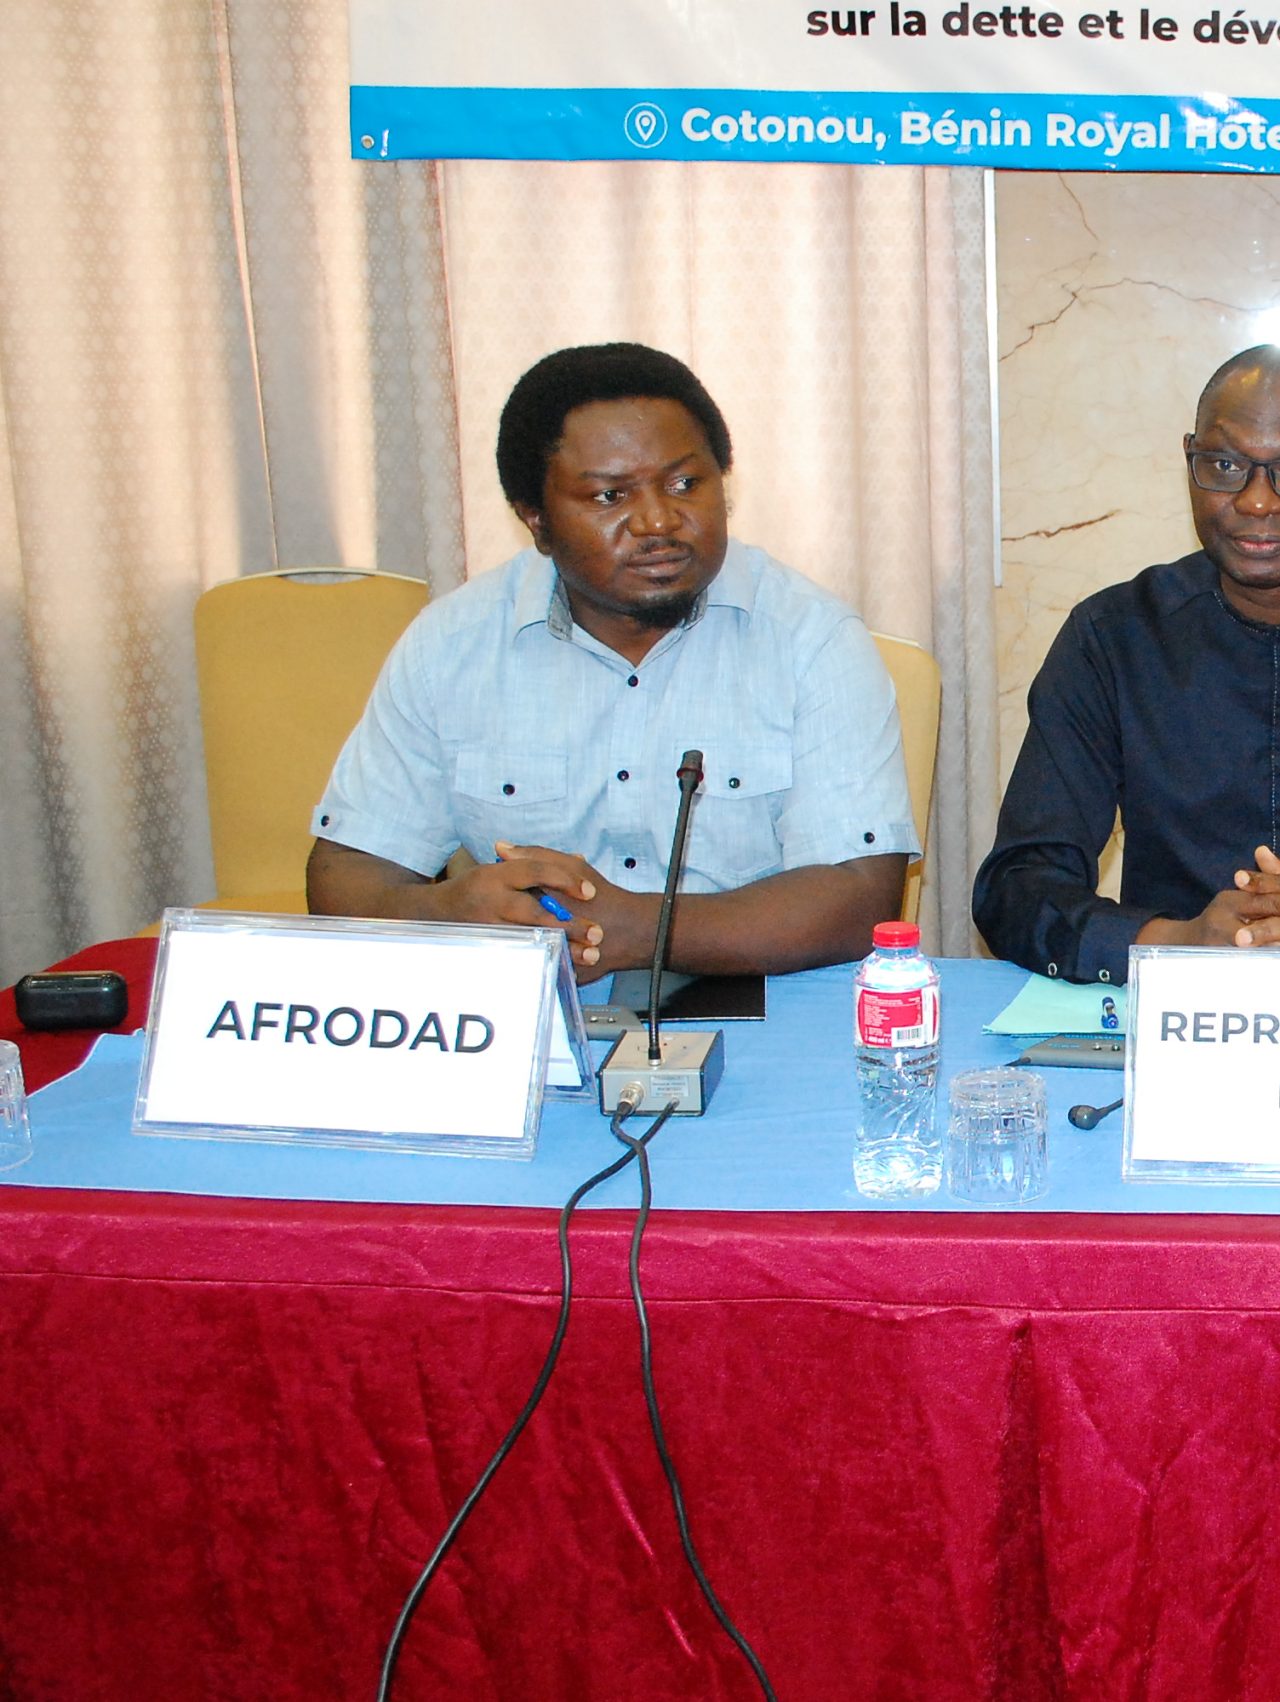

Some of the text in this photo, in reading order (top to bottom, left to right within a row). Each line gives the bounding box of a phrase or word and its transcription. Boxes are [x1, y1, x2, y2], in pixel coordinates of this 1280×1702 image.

[807, 10, 876, 37] sur
[890, 2, 927, 37] la
[942, 3, 1064, 39] dette
[1078, 10, 1125, 39] et
[1140, 9, 1179, 42] le
[682, 108, 887, 151] Cotonou,
[901, 110, 1031, 147] Bénin
[1047, 114, 1170, 156] Royal
[206, 1000, 496, 1054] AFRODAD
